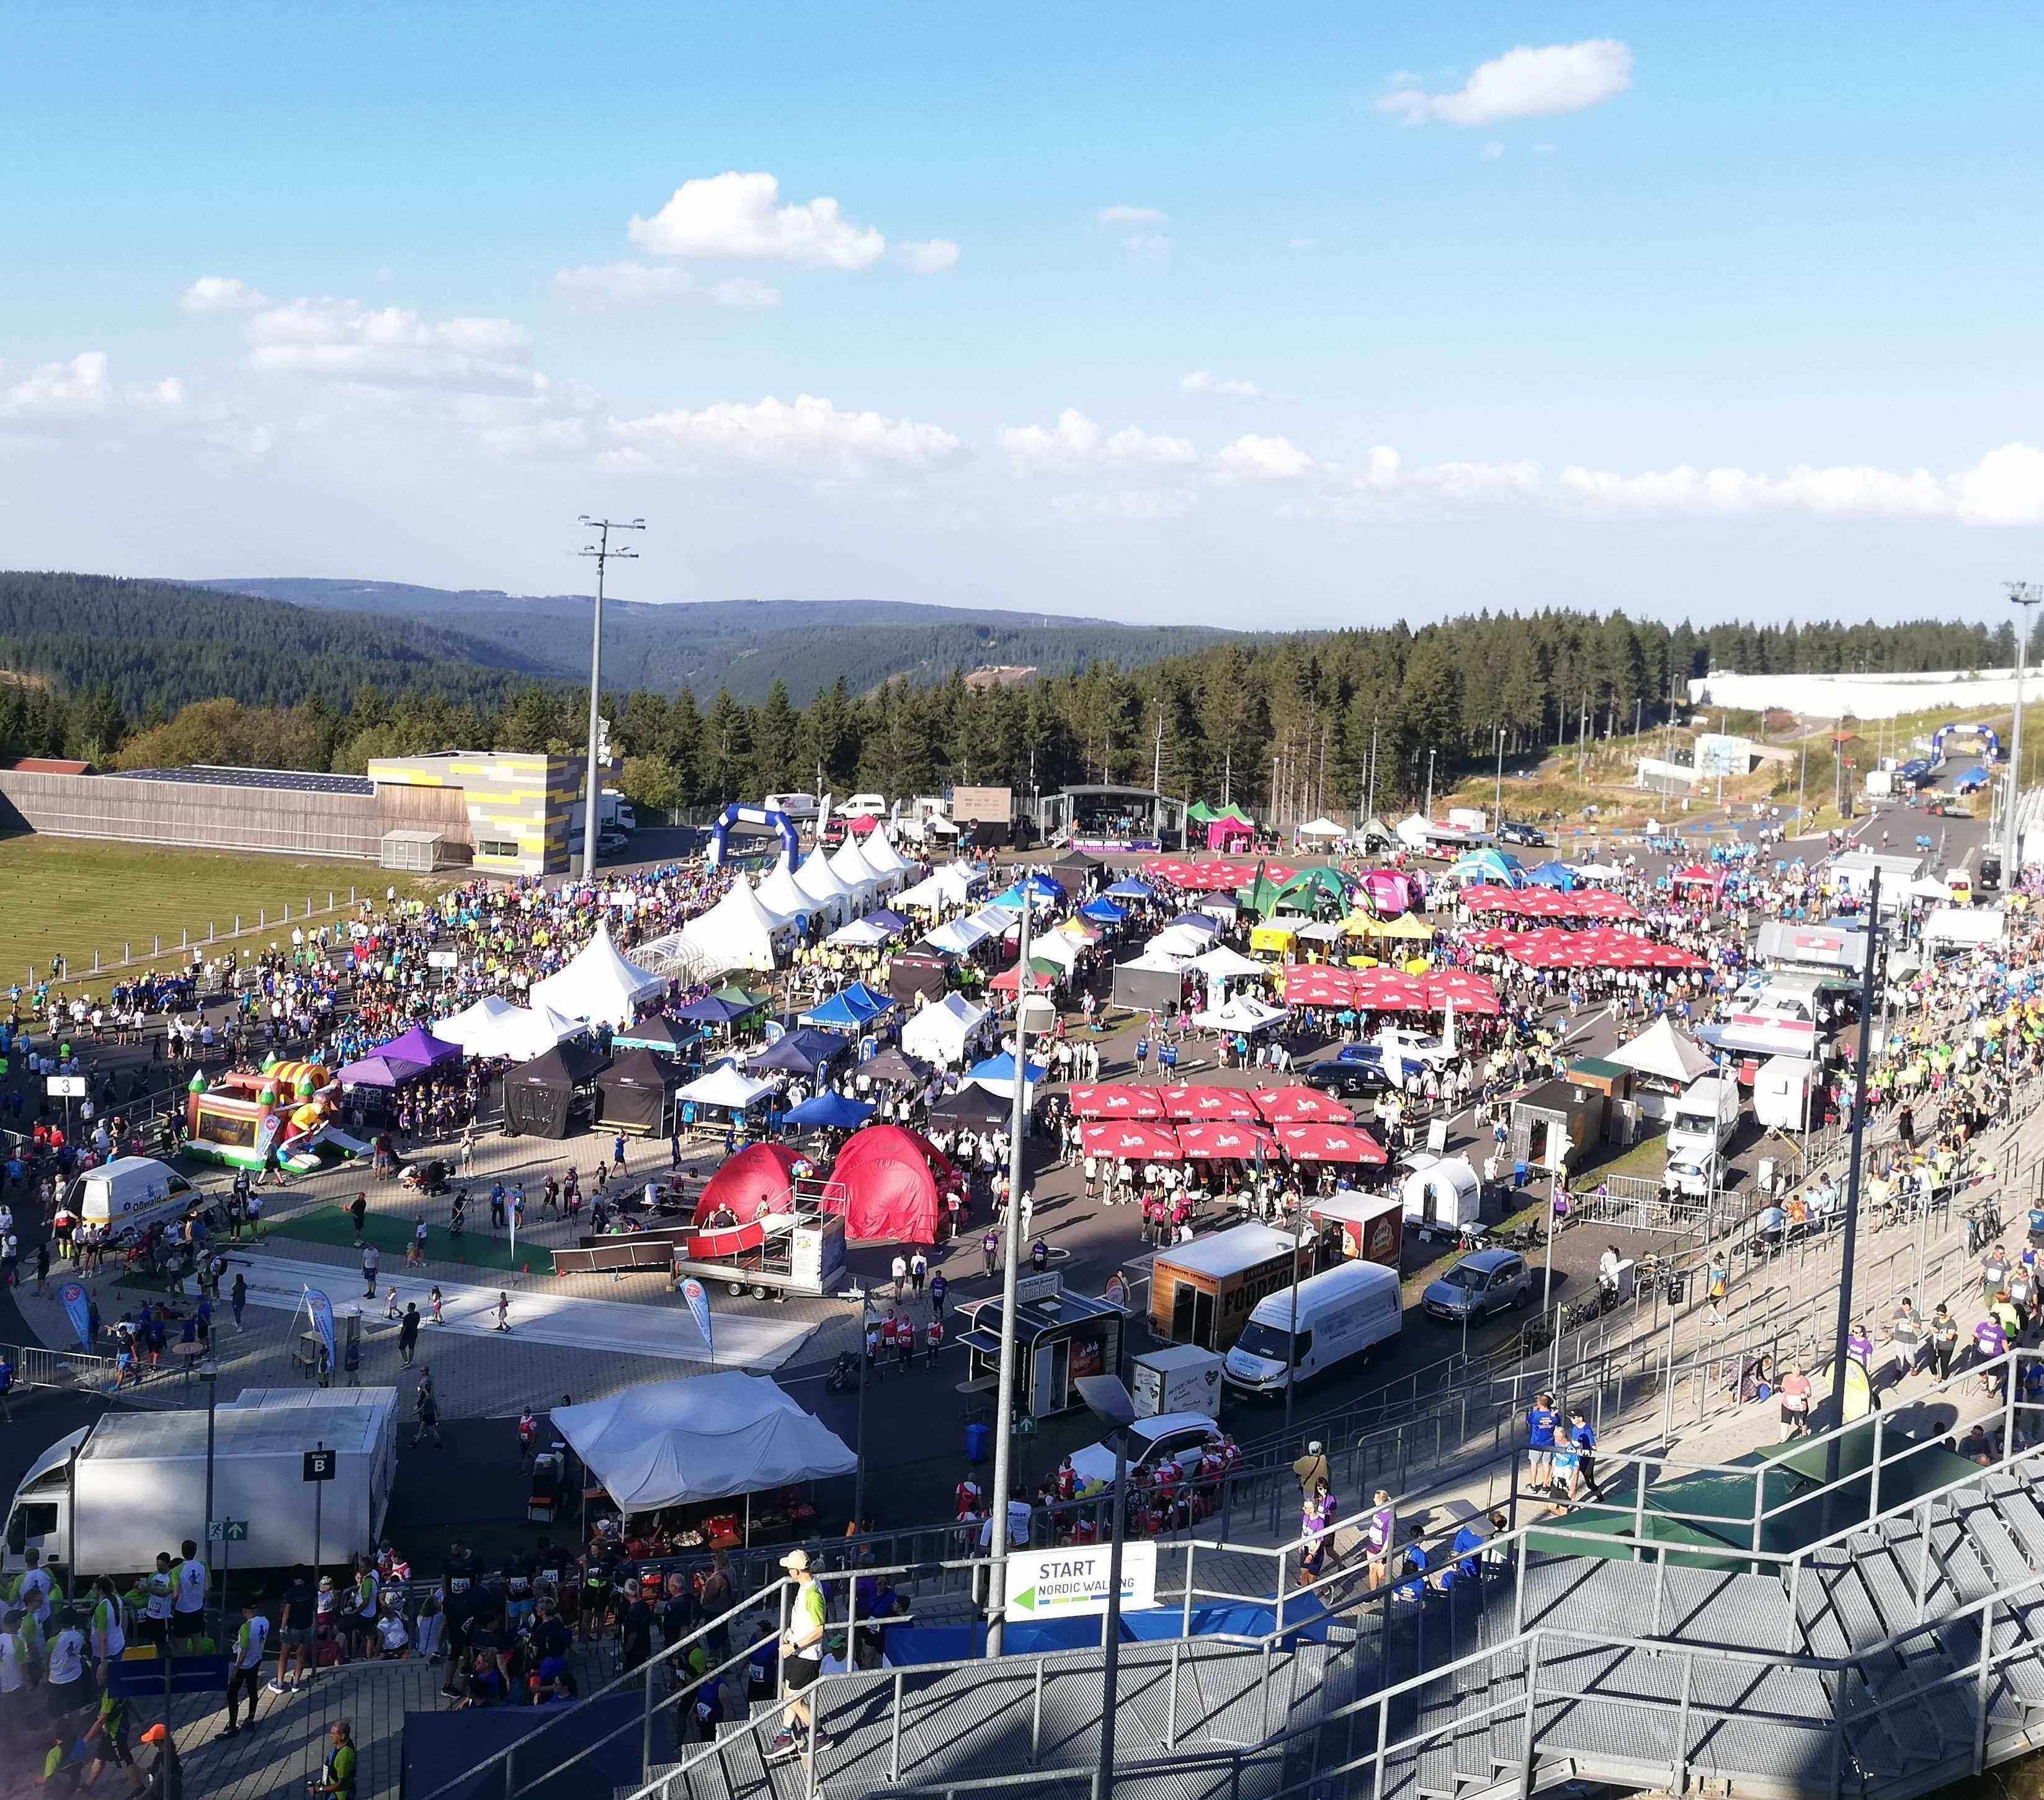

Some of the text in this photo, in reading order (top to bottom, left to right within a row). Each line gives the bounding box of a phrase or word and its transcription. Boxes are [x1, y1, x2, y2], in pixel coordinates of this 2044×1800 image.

[440, 953, 446, 964] 2
[62, 1079, 70, 1093] 3
[315, 1459, 325, 1472] B
[1040, 1560, 1096, 1580] START
[1039, 1577, 1135, 1595] NORDIC WALNG
